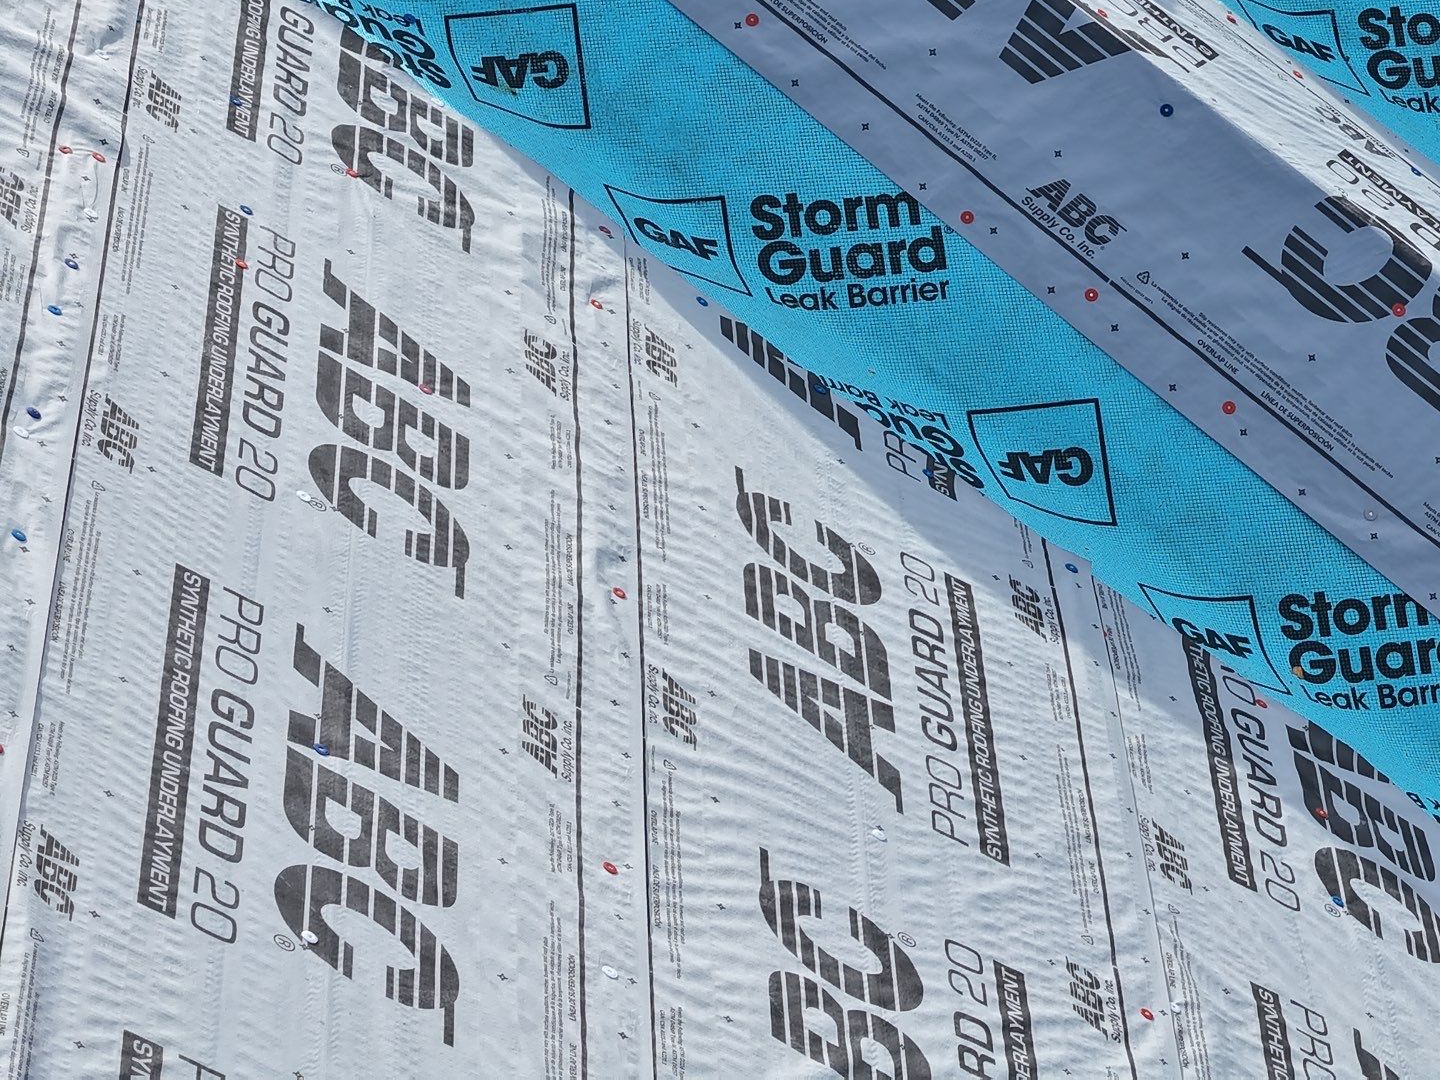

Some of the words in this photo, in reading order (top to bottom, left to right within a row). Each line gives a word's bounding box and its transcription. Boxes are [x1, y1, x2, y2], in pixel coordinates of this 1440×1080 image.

[273, 5, 315, 117] GUARD
[471, 50, 570, 89] GAF
[1262, 22, 1337, 62] GAF
[266, 111, 305, 166] 20
[633, 217, 719, 262] GAF
[750, 191, 922, 241] Storm
[757, 225, 948, 286] Guard
[254, 225, 296, 303] PRO
[765, 287, 840, 311] Leak
[847, 279, 950, 309] Barrier
[242, 300, 291, 439] GUARD
[97, 392, 140, 475] ABC
[235, 437, 278, 503] 20
[308, 257, 472, 600] ABC
[998, 446, 1094, 487] GAF
[170, 570, 202, 669] SYNTHETIC
[899, 550, 940, 607] 20
[214, 585, 265, 686] PRO
[734, 465, 904, 816] ABC
[950, 577, 983, 701] UNDERLAYMENT
[1171, 617, 1254, 658] GAF
[161, 668, 190, 753] ROOFING
[908, 608, 958, 752] GUARD
[1299, 685, 1369, 711] Leak
[521, 693, 558, 780] ABC
[966, 696, 991, 769] ROOFING
[199, 687, 255, 864] GUARD
[925, 754, 970, 848] PRO
[974, 765, 1002, 861] SYNTHETIC
[1201, 694, 1227, 757] ROOFING
[1214, 756, 1250, 889] UNDERLAYMENT
[1230, 707, 1287, 848] GUARD
[1259, 849, 1301, 912] 20
[147, 749, 183, 913] UNDERLAYMENT
[273, 622, 462, 1048] ABC
[190, 866, 240, 945] 20
